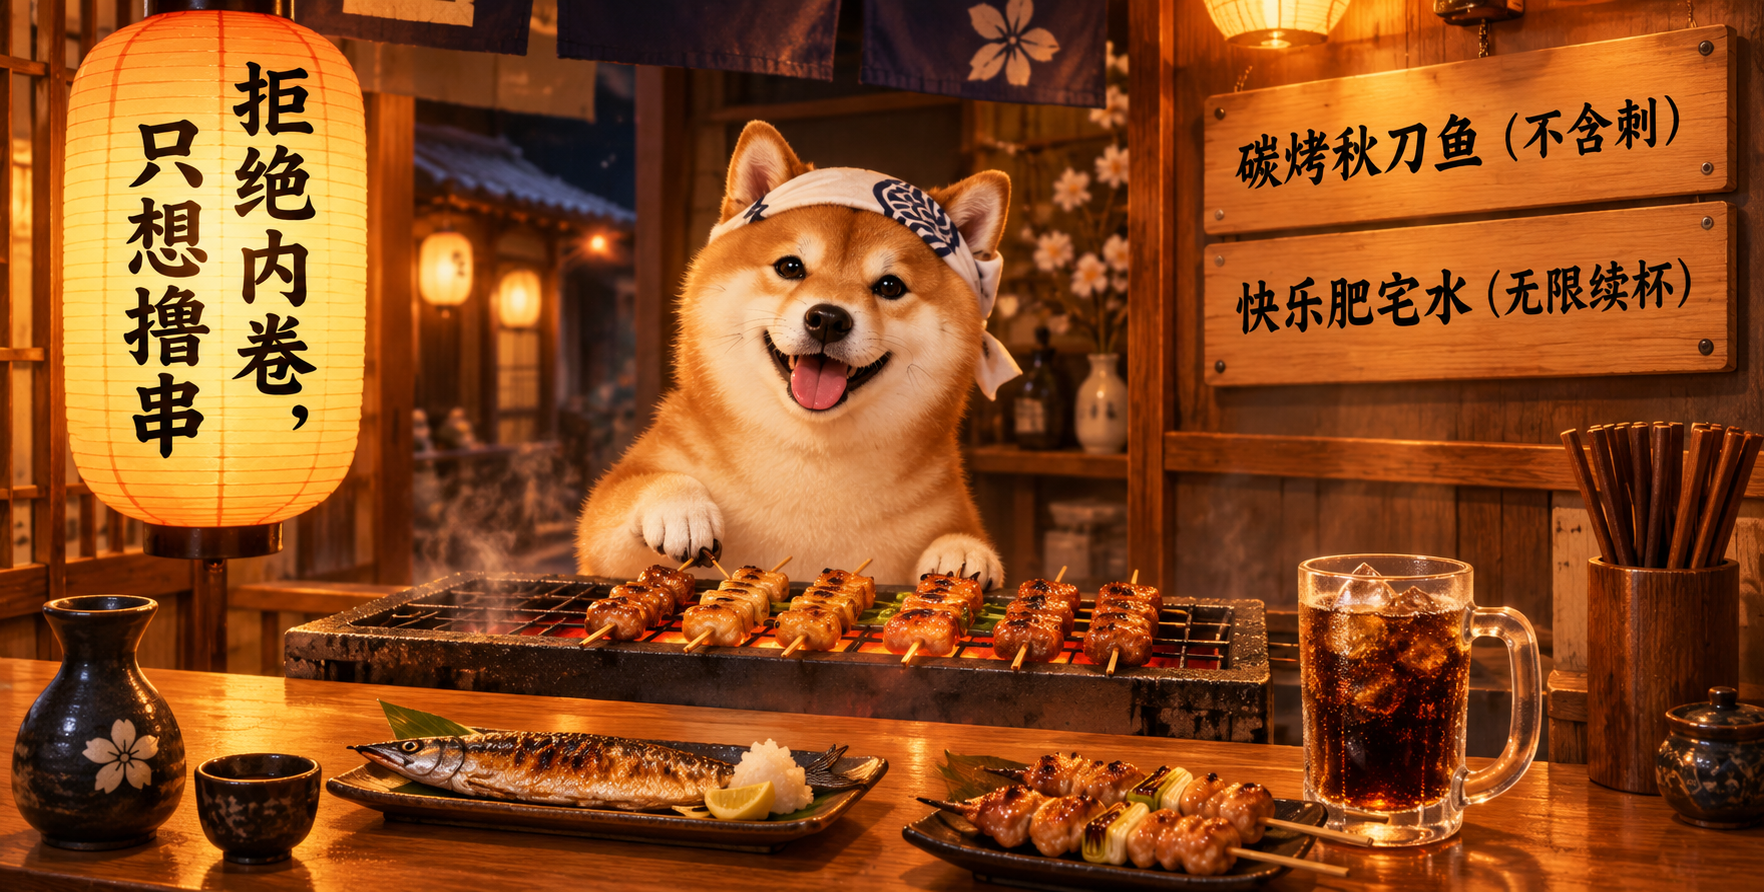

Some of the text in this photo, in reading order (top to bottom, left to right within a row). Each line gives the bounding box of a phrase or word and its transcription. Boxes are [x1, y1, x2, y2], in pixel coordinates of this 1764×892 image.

[123, 119, 210, 459] 只想撸串
[232, 61, 317, 431] 拒绝内卷，
